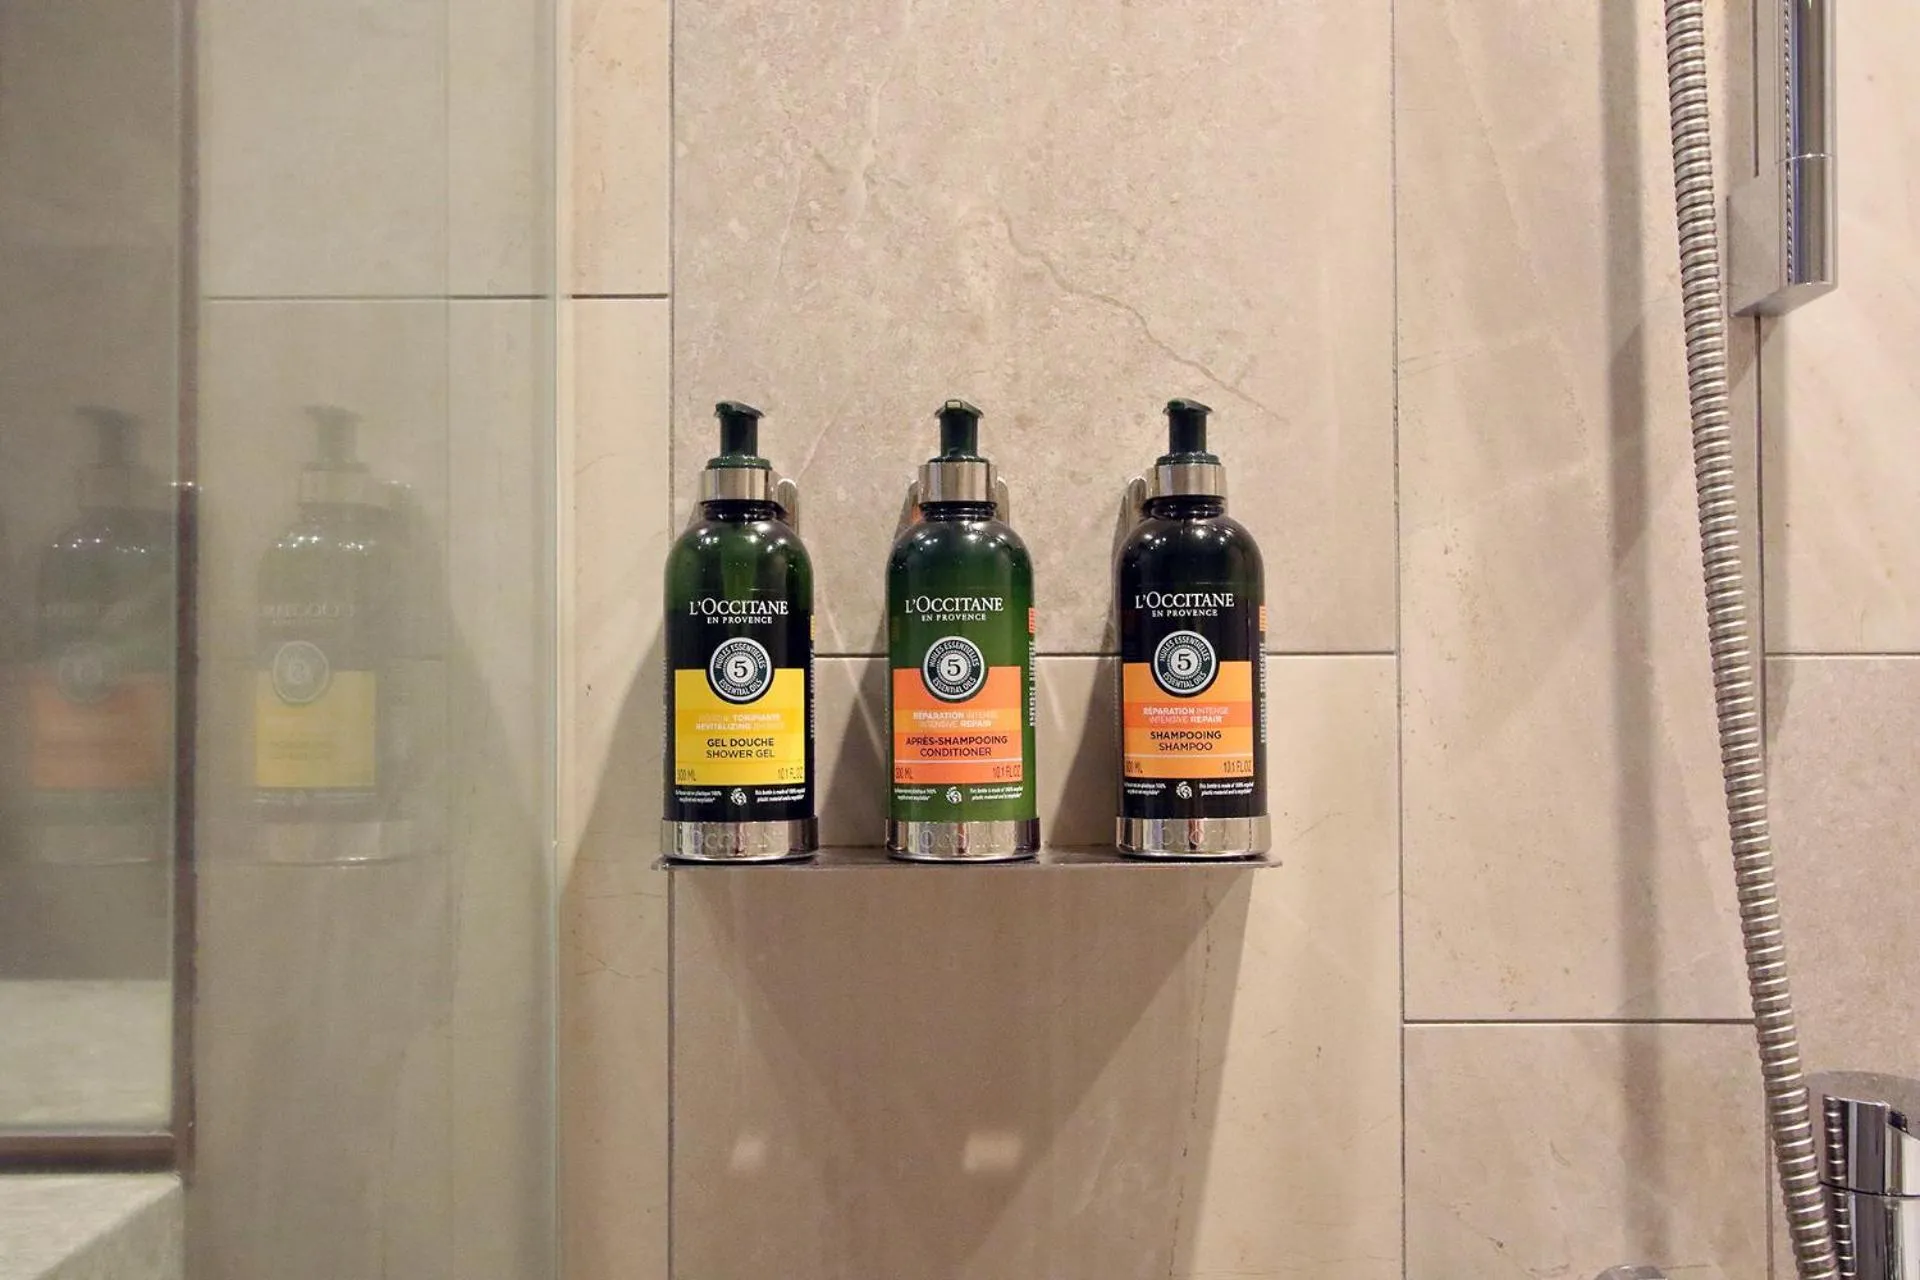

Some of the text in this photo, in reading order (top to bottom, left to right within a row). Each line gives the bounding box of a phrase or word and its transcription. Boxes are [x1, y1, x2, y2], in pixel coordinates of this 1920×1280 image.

[921, 613, 987, 622] EN PROVENCE
[1151, 608, 1218, 617] EN PROVENCE
[707, 616, 773, 624] EN PROVENCE
[1177, 653, 1192, 671] 5
[734, 660, 748, 678] 5
[947, 659, 961, 676] 5
[1193, 671, 1207, 685] OILS
[749, 678, 763, 692] OILS
[1150, 730, 1222, 740] SHAMPOOING
[707, 738, 774, 747] GEL DOUCHE
[1159, 742, 1213, 751] SHAMPOO
[706, 749, 775, 759] SHOWER GEL
[920, 747, 992, 757] CONDITIONER
